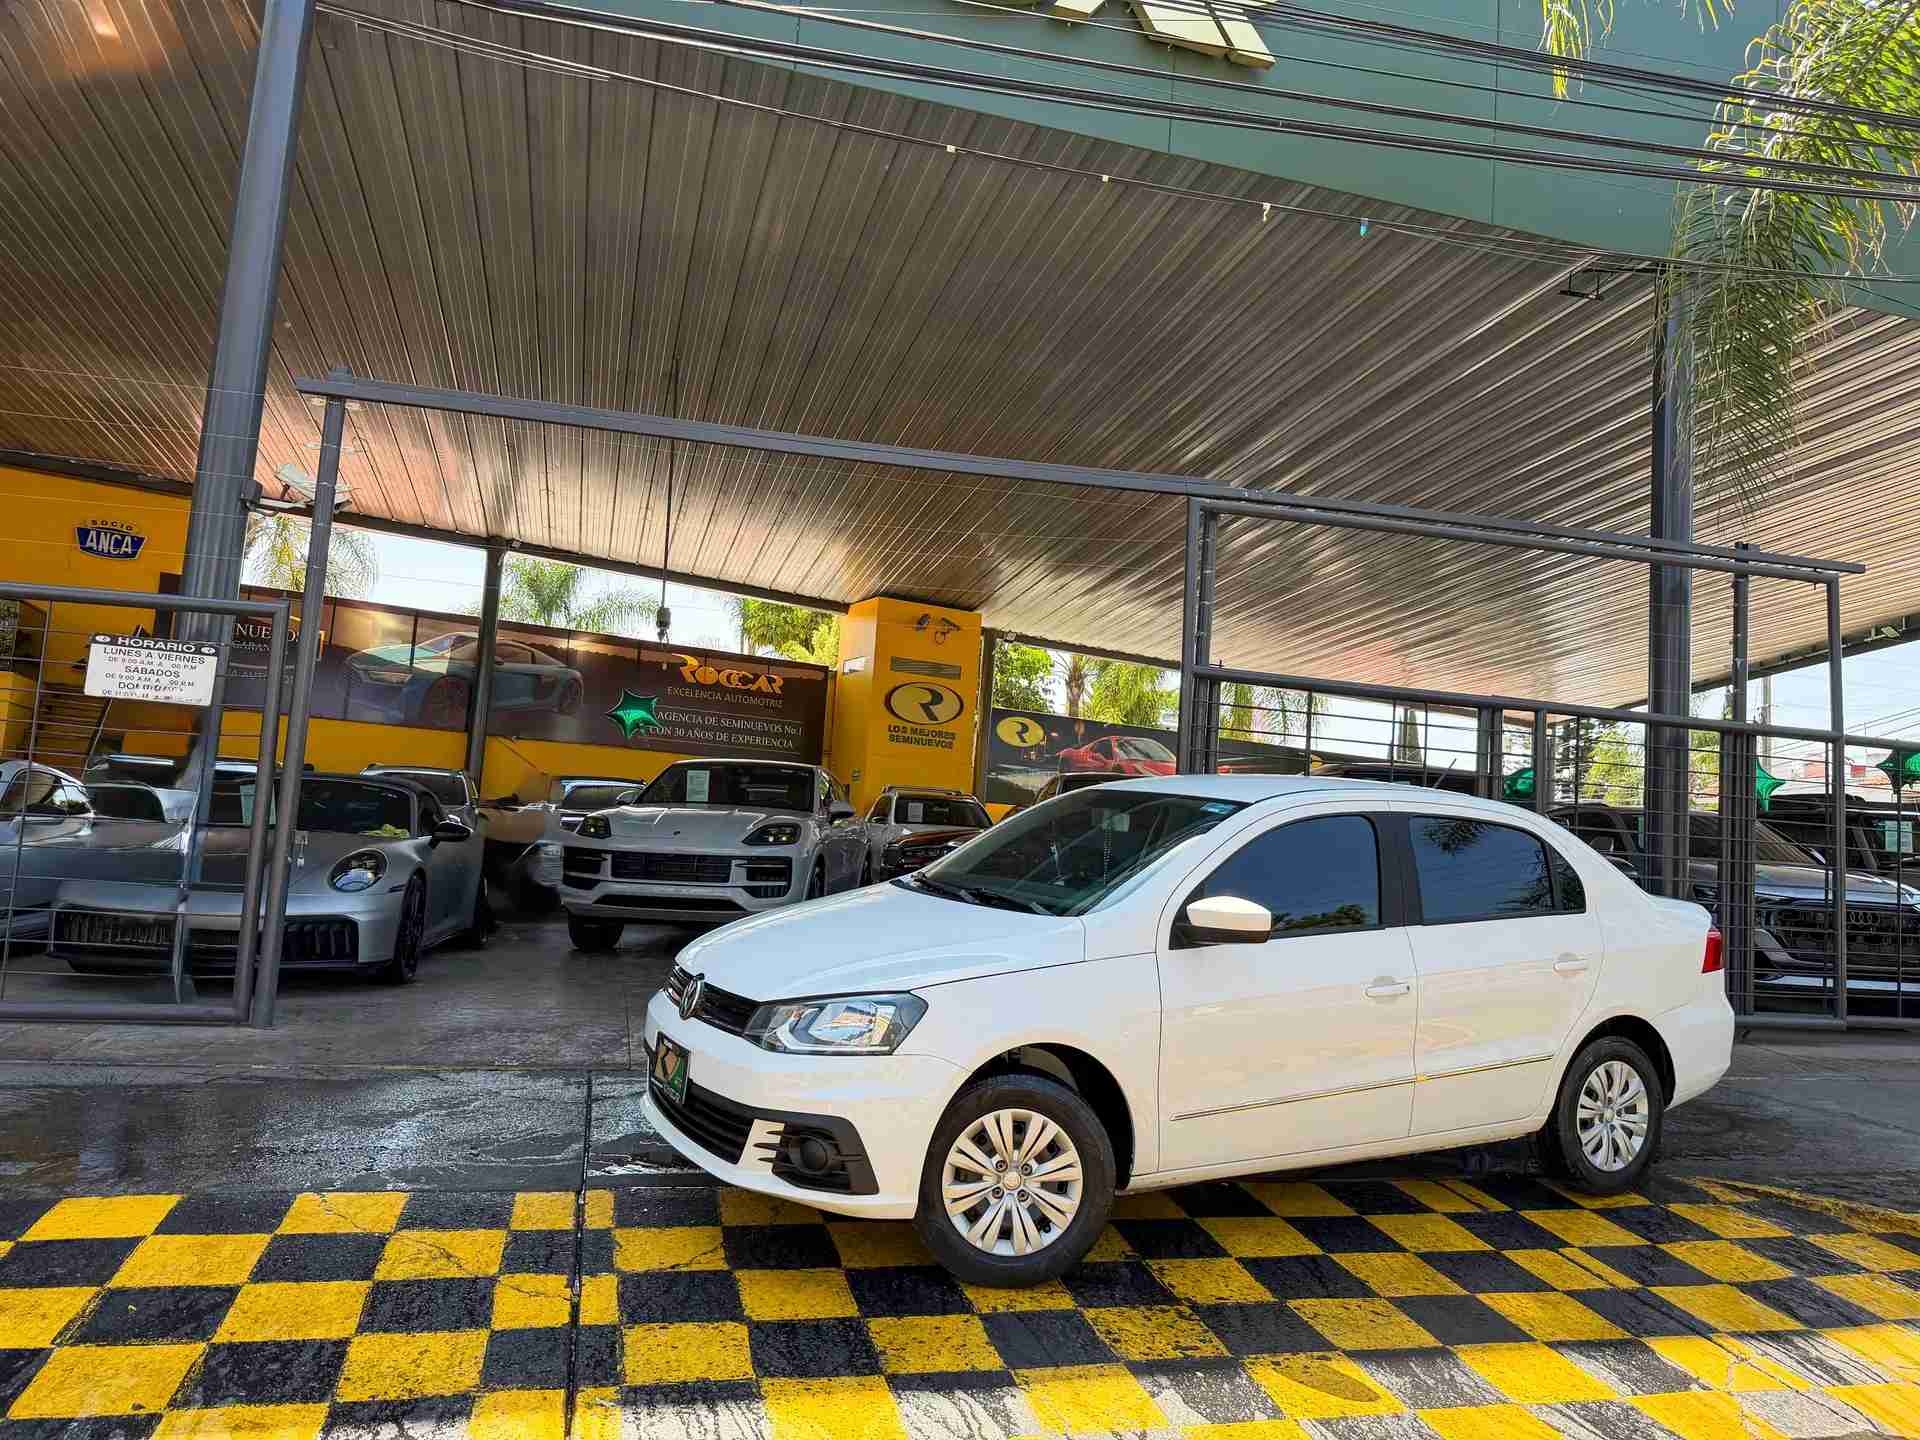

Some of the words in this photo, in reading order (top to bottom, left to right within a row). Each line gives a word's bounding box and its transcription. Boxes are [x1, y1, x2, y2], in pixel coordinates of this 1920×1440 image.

[86, 528, 132, 554] ANCA
[117, 636, 196, 652] HORARIO
[103, 647, 142, 658] LUNES
[145, 651, 153, 659] A
[158, 653, 206, 665] VIERNES
[671, 652, 785, 695] ROCCAR
[667, 686, 722, 701] EXCELENCIA
[725, 692, 784, 708] AUTOMOTRIZ
[657, 711, 703, 725] AGENCIA
[705, 716, 719, 727] DE
[720, 718, 783, 733] SEMINUEVOS
[888, 724, 908, 734] LOS
[910, 727, 956, 741] MEJORES
[648, 726, 672, 737] CON
[674, 727, 685, 737] 30
[687, 727, 714, 740] AÑOS
[716, 732, 730, 742] DE
[731, 733, 794, 749] EXPERIENCIA
[888, 734, 954, 750] SEMINUEVOS
